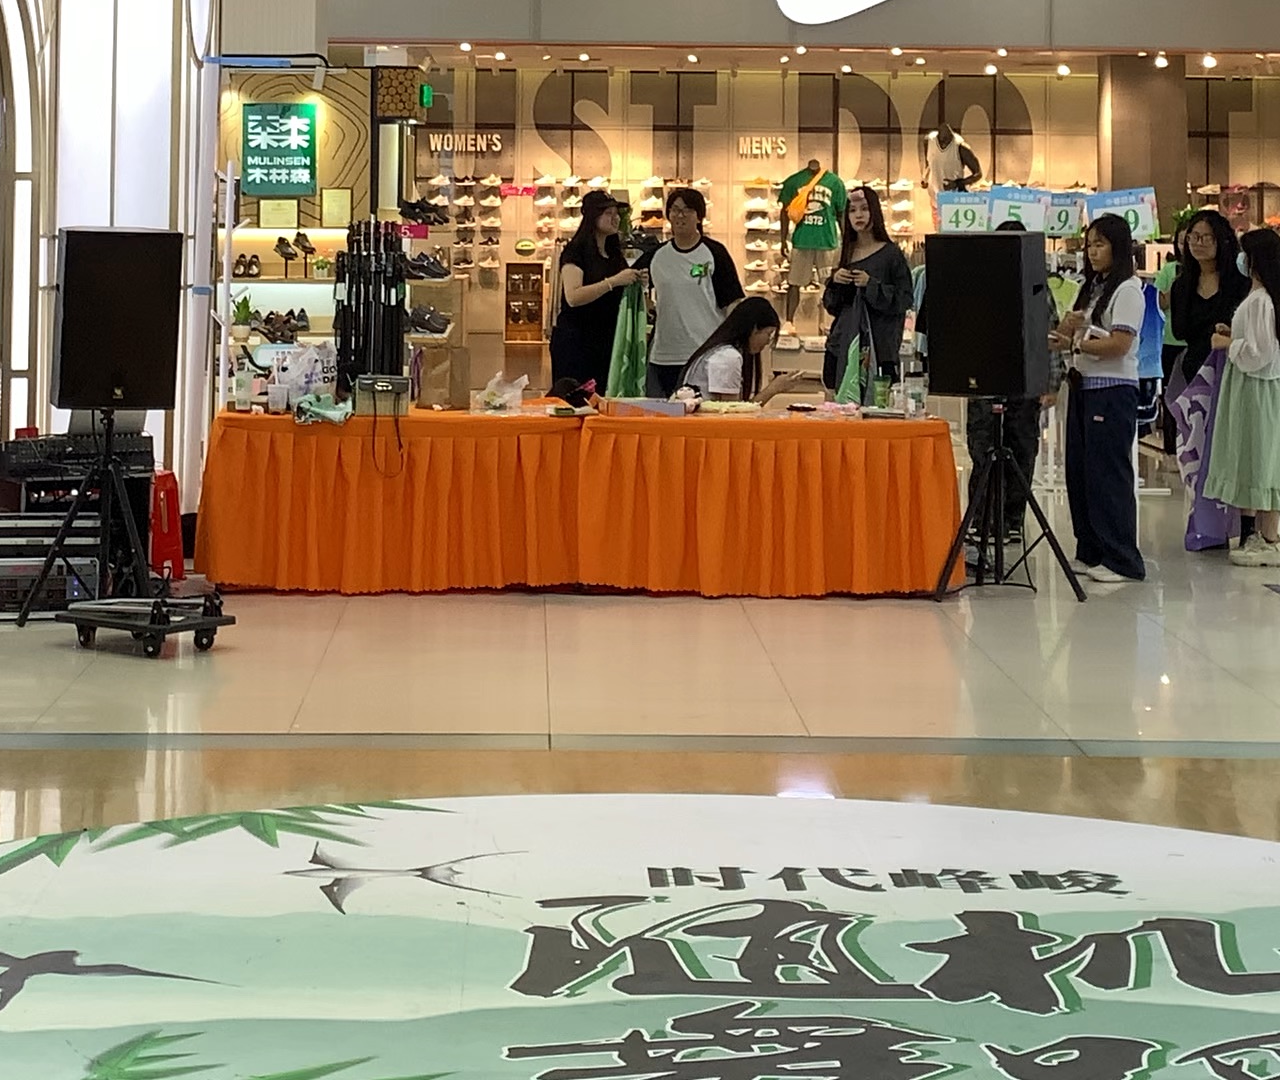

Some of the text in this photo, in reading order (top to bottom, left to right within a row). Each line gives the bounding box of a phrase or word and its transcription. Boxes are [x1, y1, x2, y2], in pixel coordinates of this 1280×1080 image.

[429, 133, 503, 152] WOMEN'S
[738, 136, 788, 155] MEN'S
[247, 156, 311, 166] MULINSEN
[247, 167, 311, 184] 木林森
[948, 208, 977, 229] 49
[645, 865, 1133, 895] 时代峰峻
